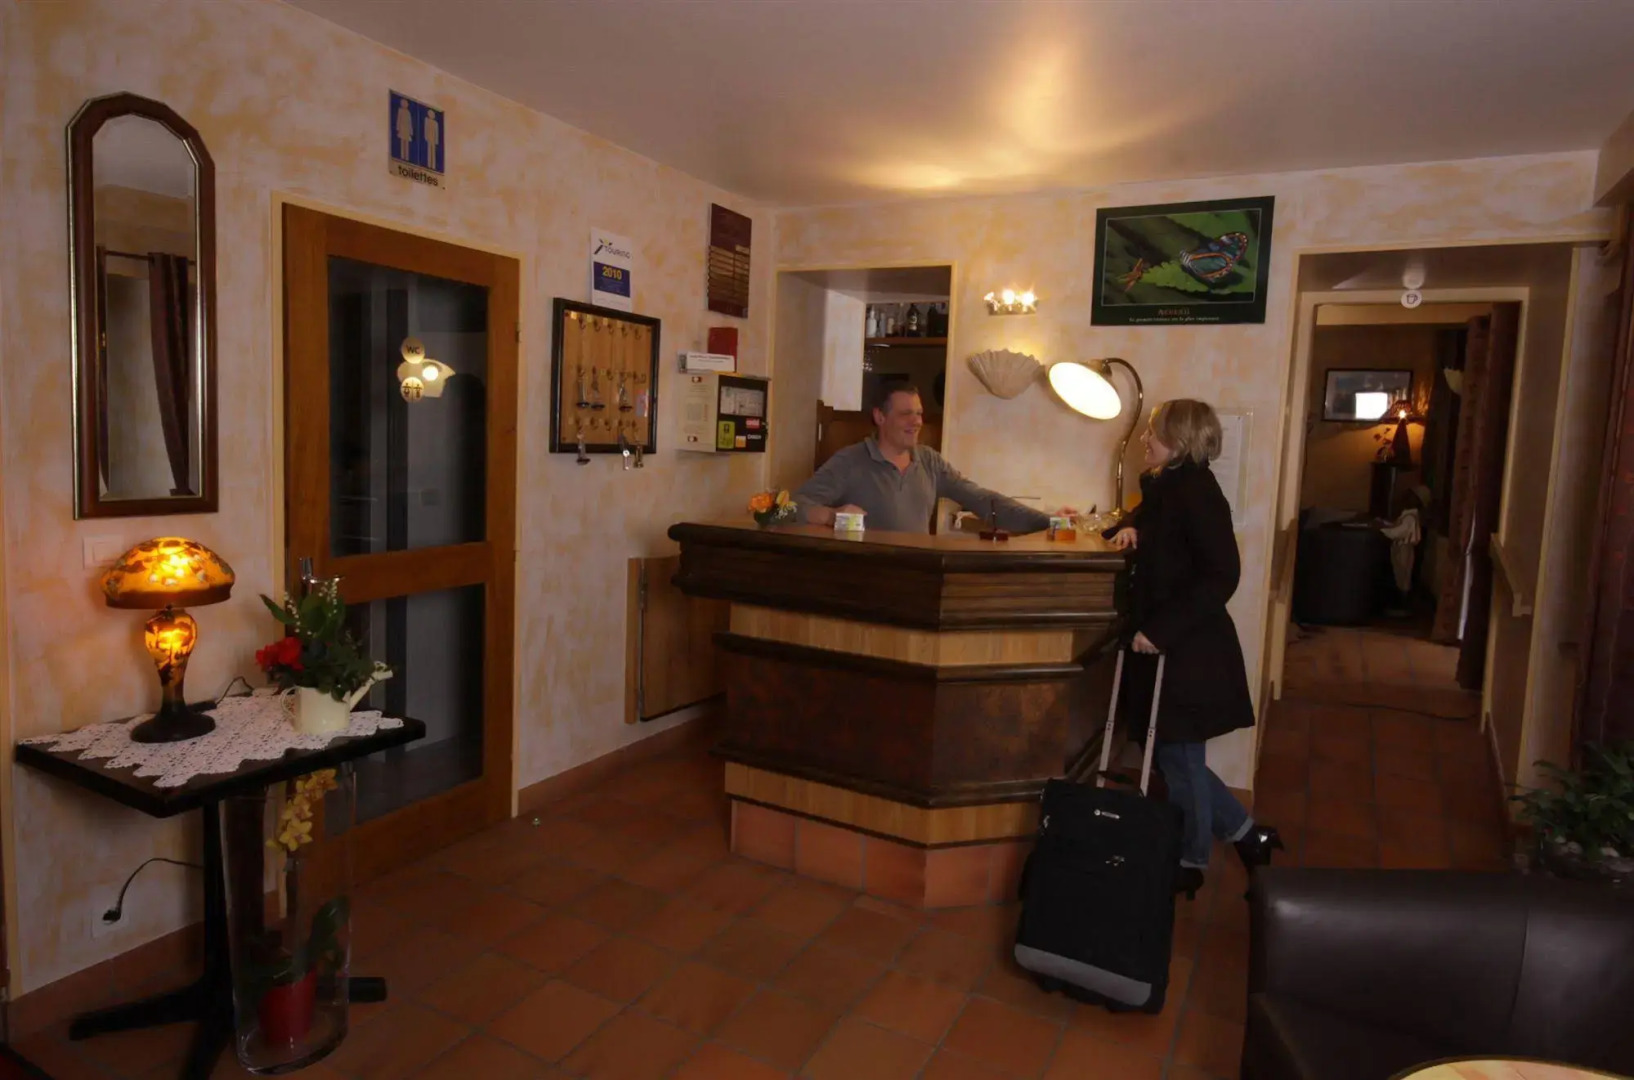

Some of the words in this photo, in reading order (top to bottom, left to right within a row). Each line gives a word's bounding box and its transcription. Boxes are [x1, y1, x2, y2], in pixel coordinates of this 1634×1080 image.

[398, 165, 438, 186] toilettes
[602, 265, 622, 280] 2010
[405, 344, 421, 354] WC
